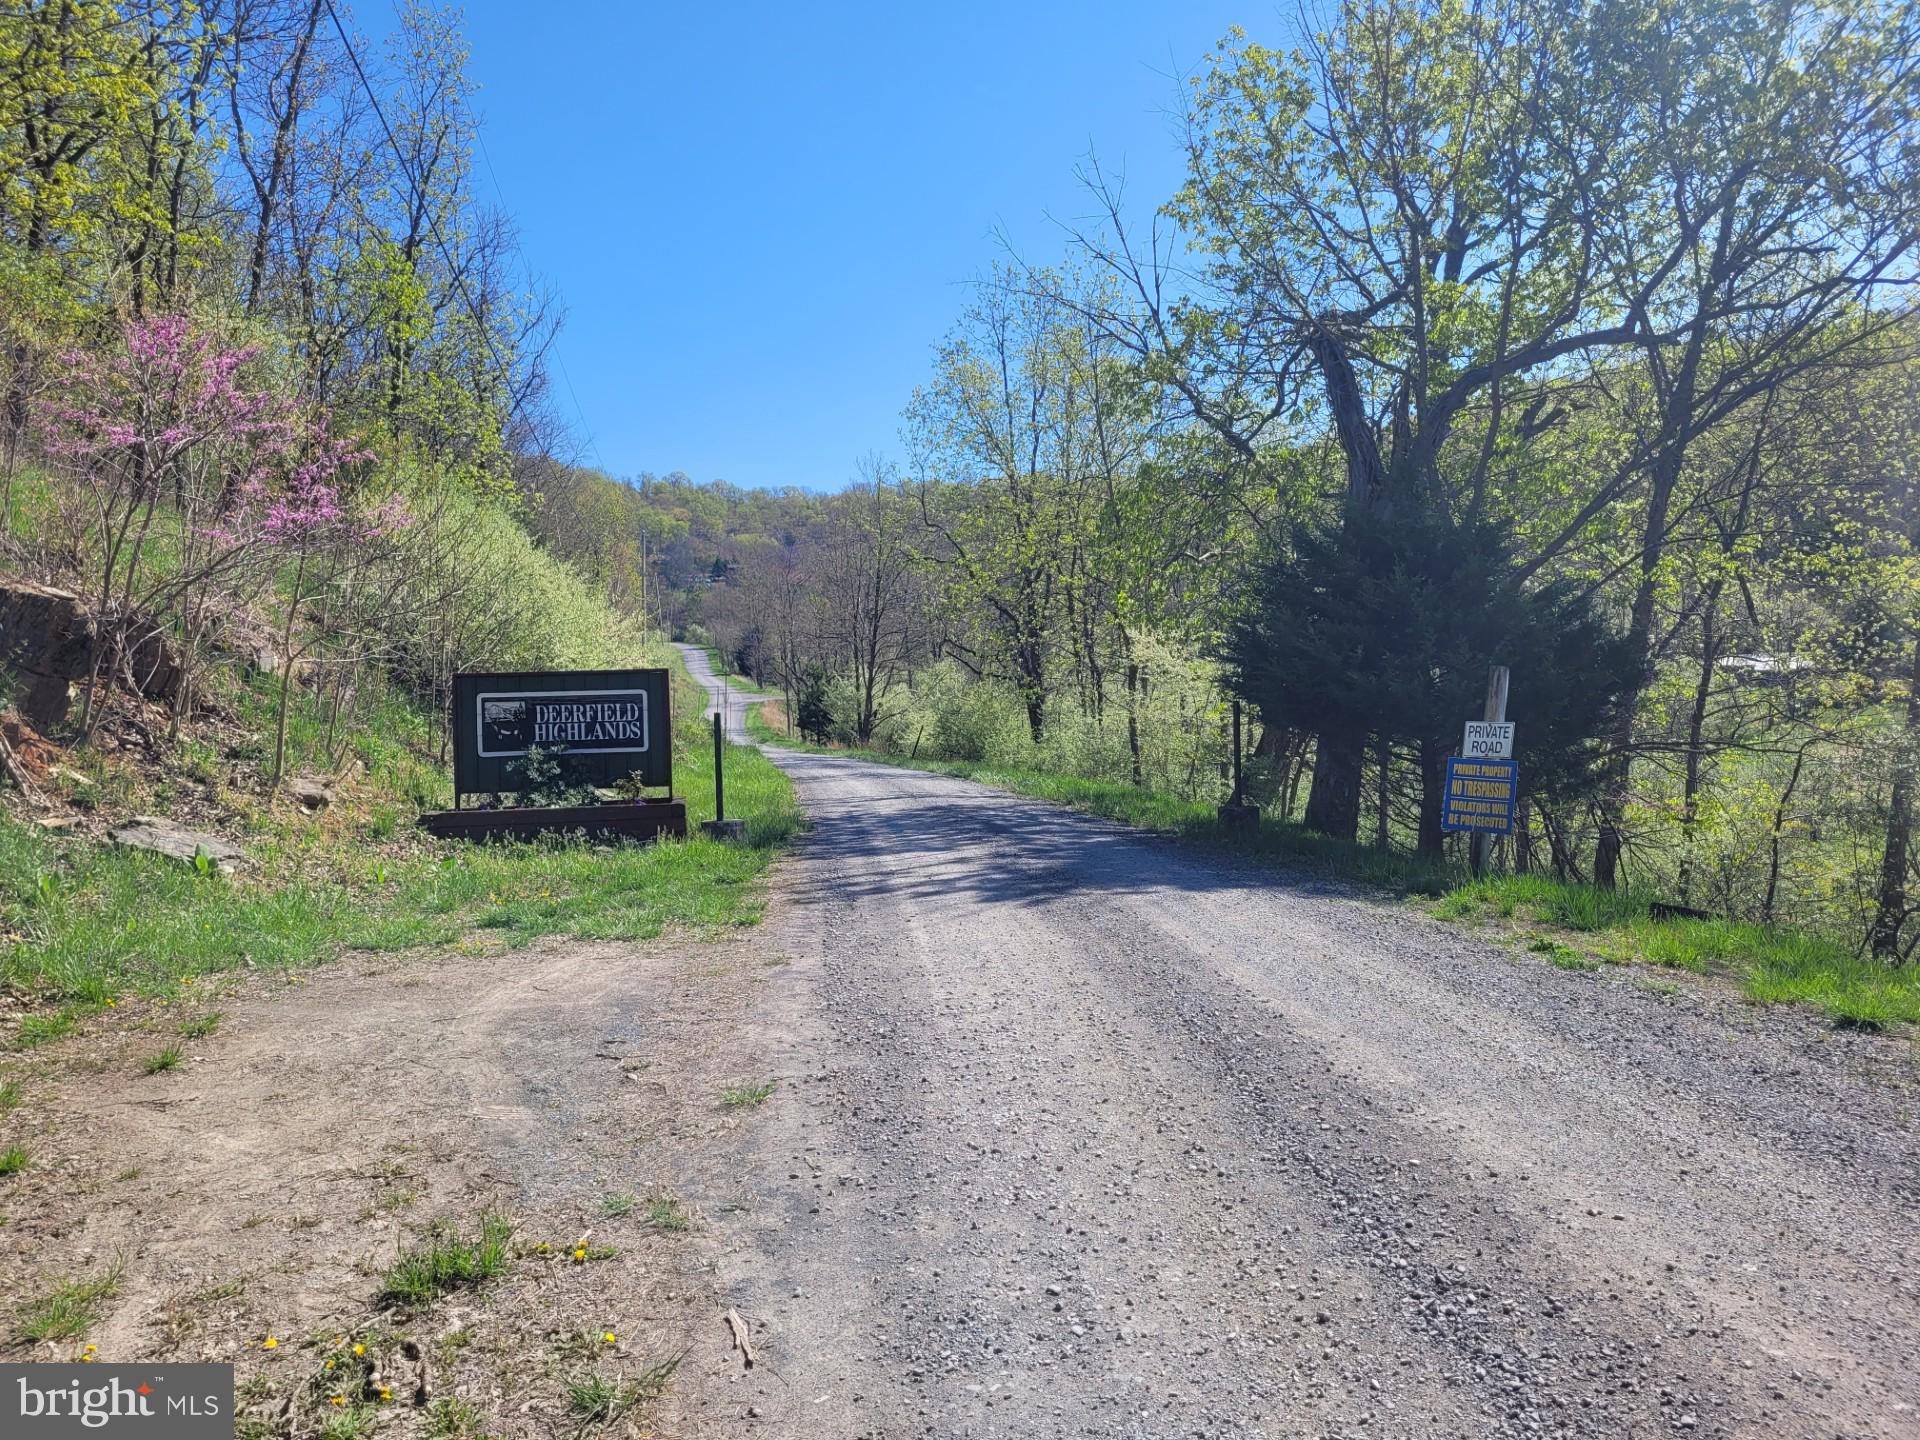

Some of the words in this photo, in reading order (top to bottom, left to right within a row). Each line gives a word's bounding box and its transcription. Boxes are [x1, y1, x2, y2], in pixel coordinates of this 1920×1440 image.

[535, 703, 640, 724] DEERFIELD
[534, 721, 641, 742] HIGHLANDS
[1468, 725, 1511, 739] PRIVATE
[1471, 740, 1503, 753] ROAD
[1453, 763, 1480, 776] PRIVATE
[1481, 765, 1513, 778] PROPERTY
[1451, 779, 1463, 795] NO
[1463, 780, 1511, 798] TRESPASSING
[1450, 799, 1491, 814] VIOLATORS
[1491, 802, 1509, 815] WILL
[1448, 813, 1459, 825] BE
[1460, 814, 1508, 830] PROSECUTED
